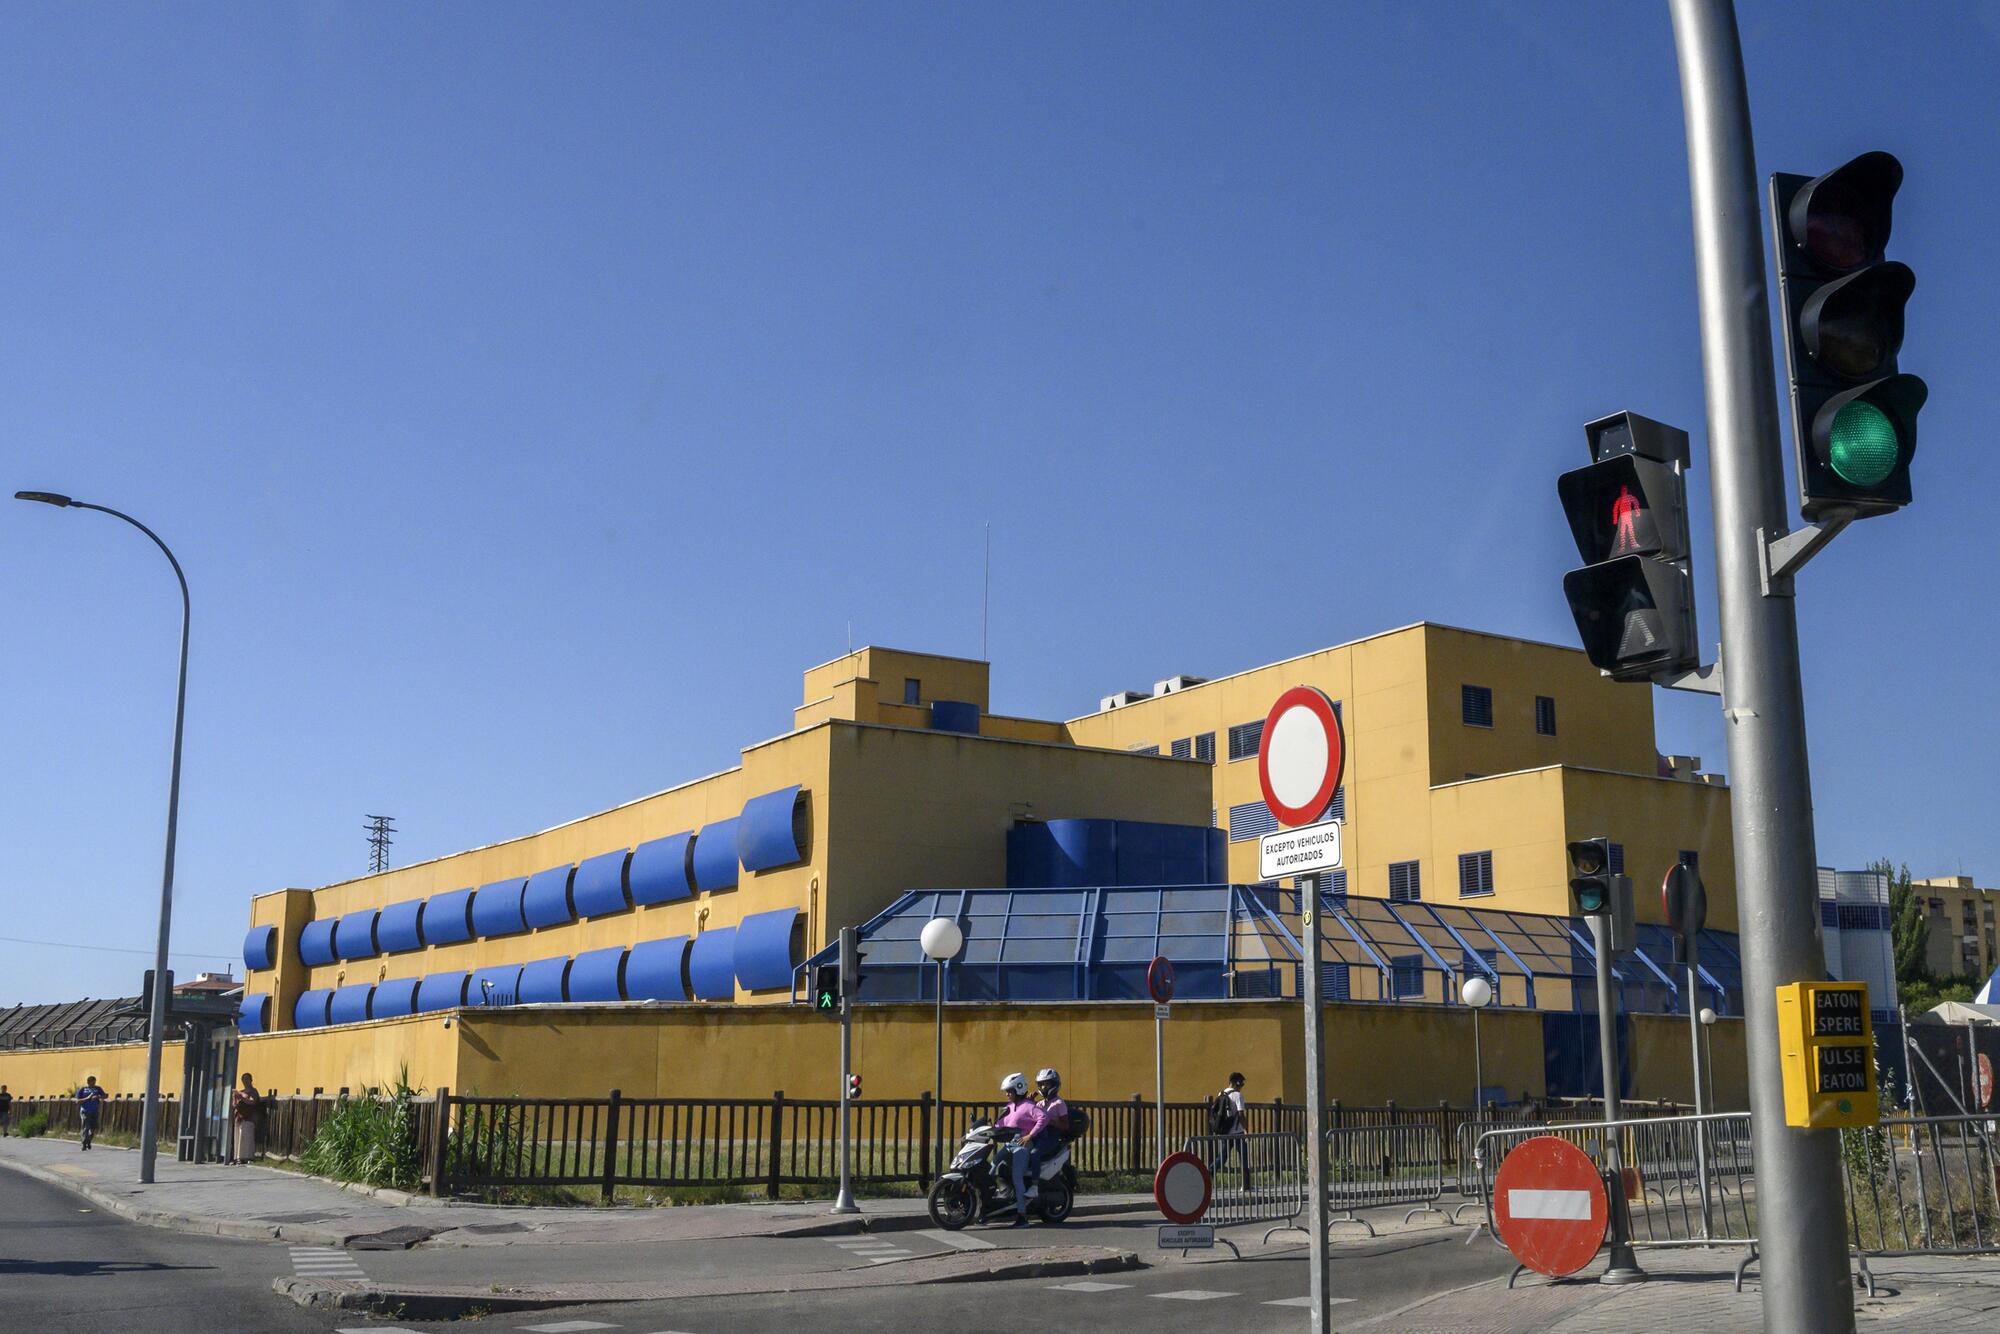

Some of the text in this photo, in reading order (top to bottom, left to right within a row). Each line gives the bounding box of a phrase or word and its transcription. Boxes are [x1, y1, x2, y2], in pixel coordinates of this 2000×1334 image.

[1265, 832, 1335, 855] EXCEPTO VEHICULOS
[1276, 849, 1324, 867] AUTORIZADOS
[1819, 1072, 1865, 1089] EATON
